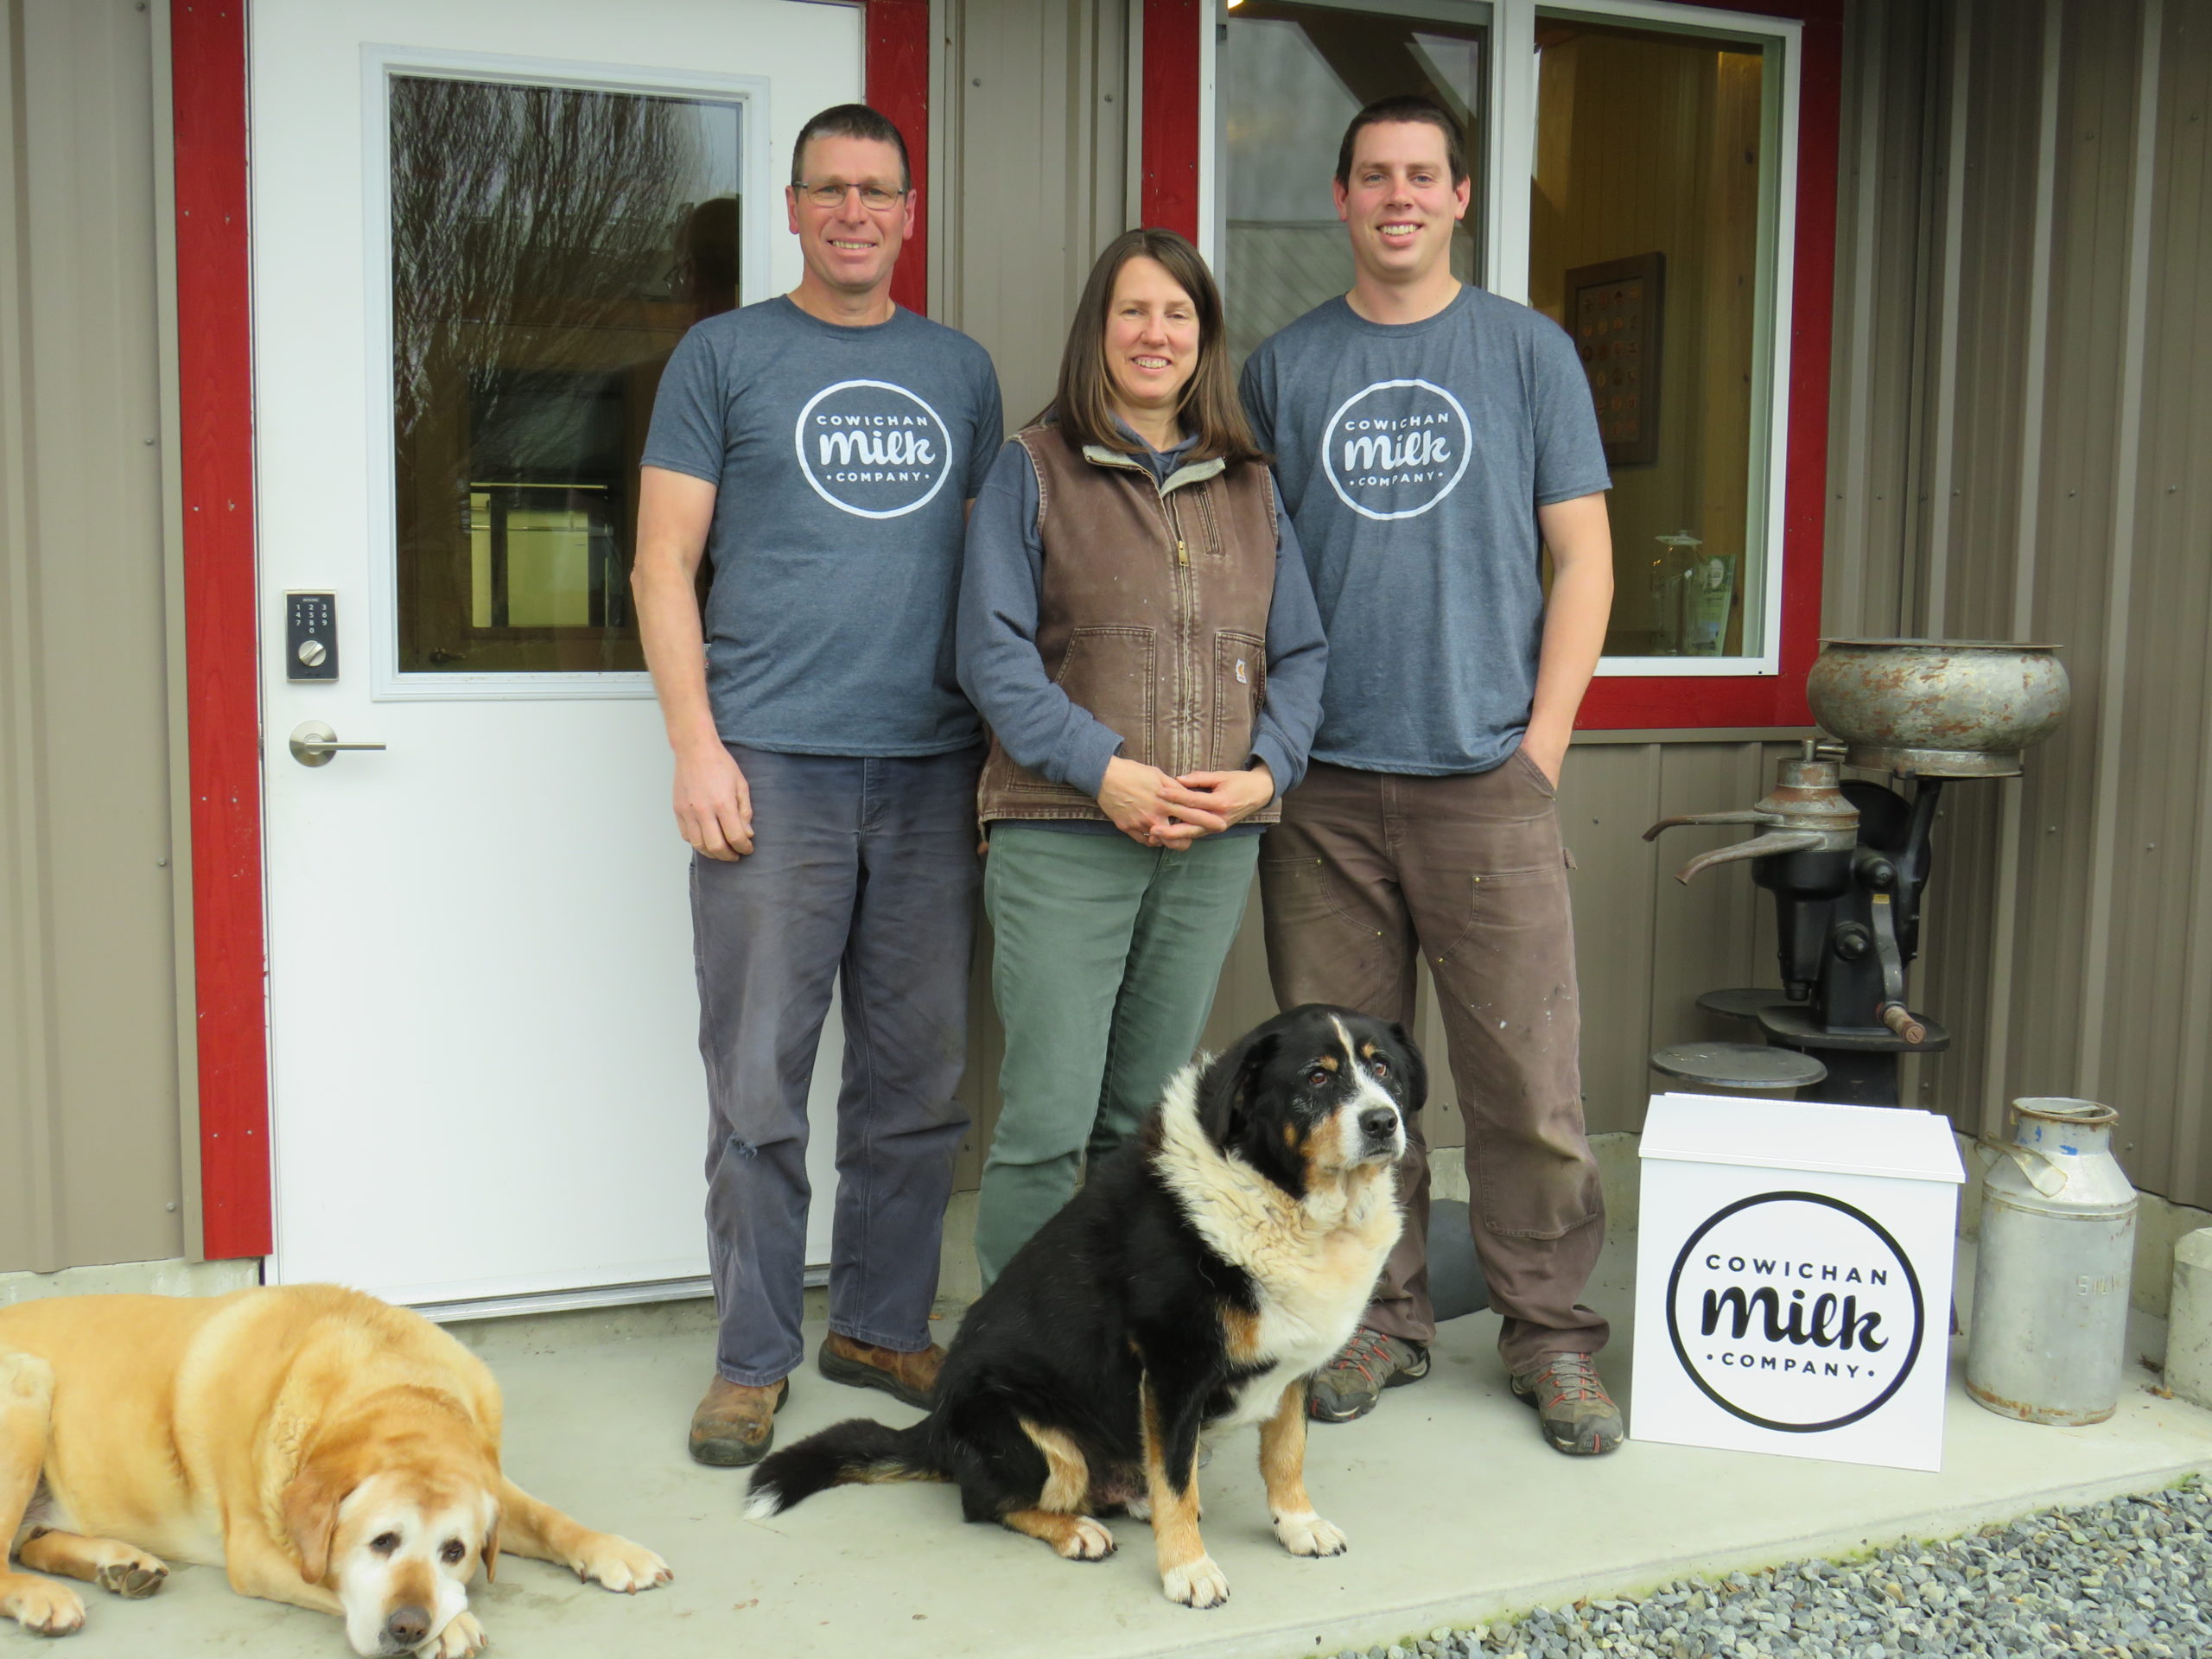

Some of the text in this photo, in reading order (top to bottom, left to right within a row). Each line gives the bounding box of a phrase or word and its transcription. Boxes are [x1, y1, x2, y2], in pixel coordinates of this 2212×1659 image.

[816, 415, 929, 426] COWICHAN
[1344, 412, 1450, 431] COWICHAN
[819, 430, 936, 466] milk
[1344, 430, 1452, 472] milk
[836, 472, 921, 482] COMPANY
[1705, 1254, 1888, 1286] COWICHAN
[1700, 1286, 1890, 1353] milk
[1721, 1351, 1859, 1378] COMPANY
